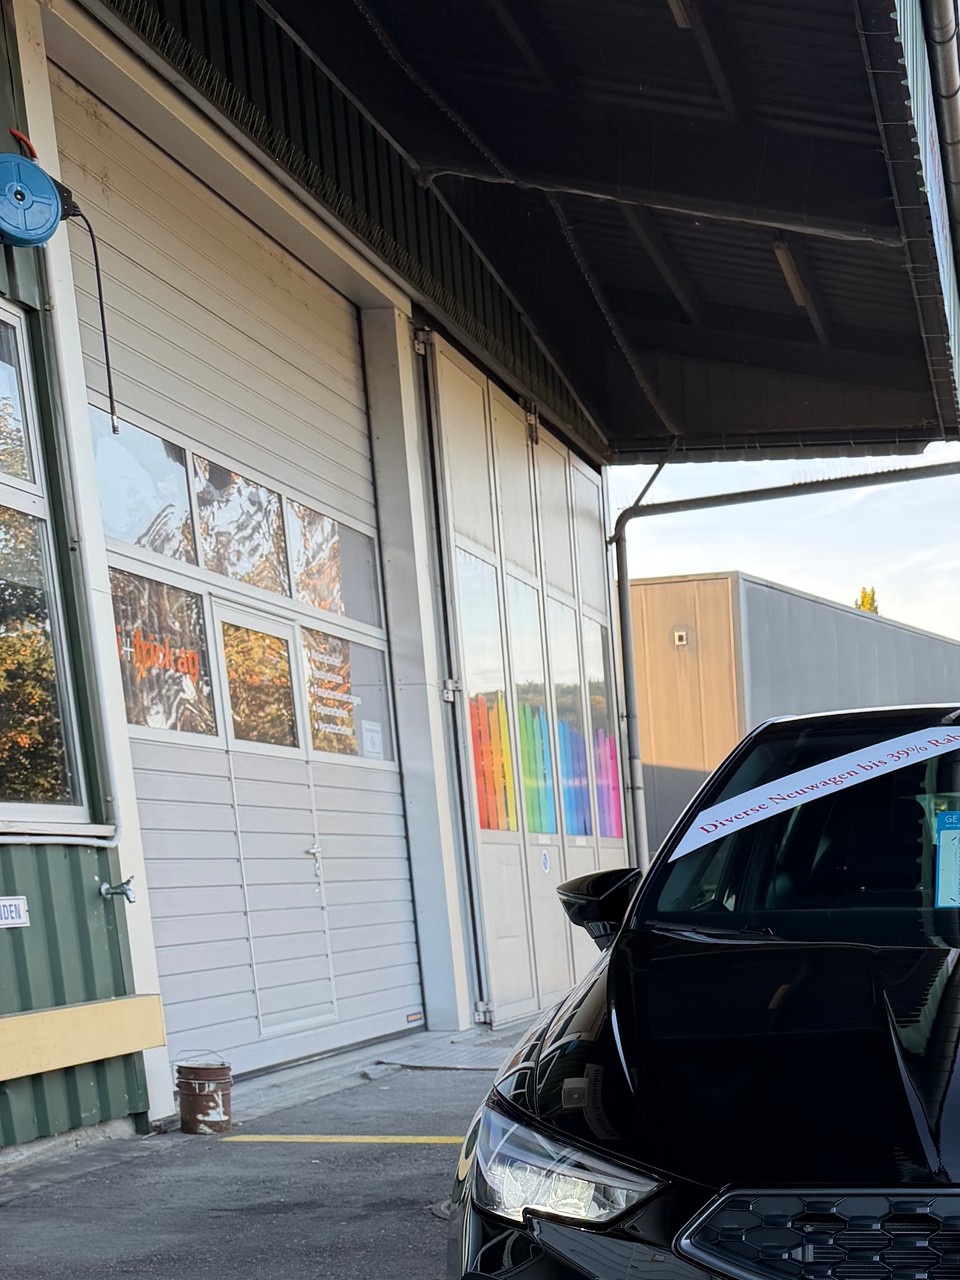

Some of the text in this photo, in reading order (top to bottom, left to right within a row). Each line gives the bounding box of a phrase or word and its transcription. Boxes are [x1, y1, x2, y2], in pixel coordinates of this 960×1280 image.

[699, 802, 769, 834] Diverse
[767, 769, 859, 805] Neuwagen
[856, 759, 888, 771] bis
[886, 745, 928, 762] 39%
[945, 815, 958, 823] GE
